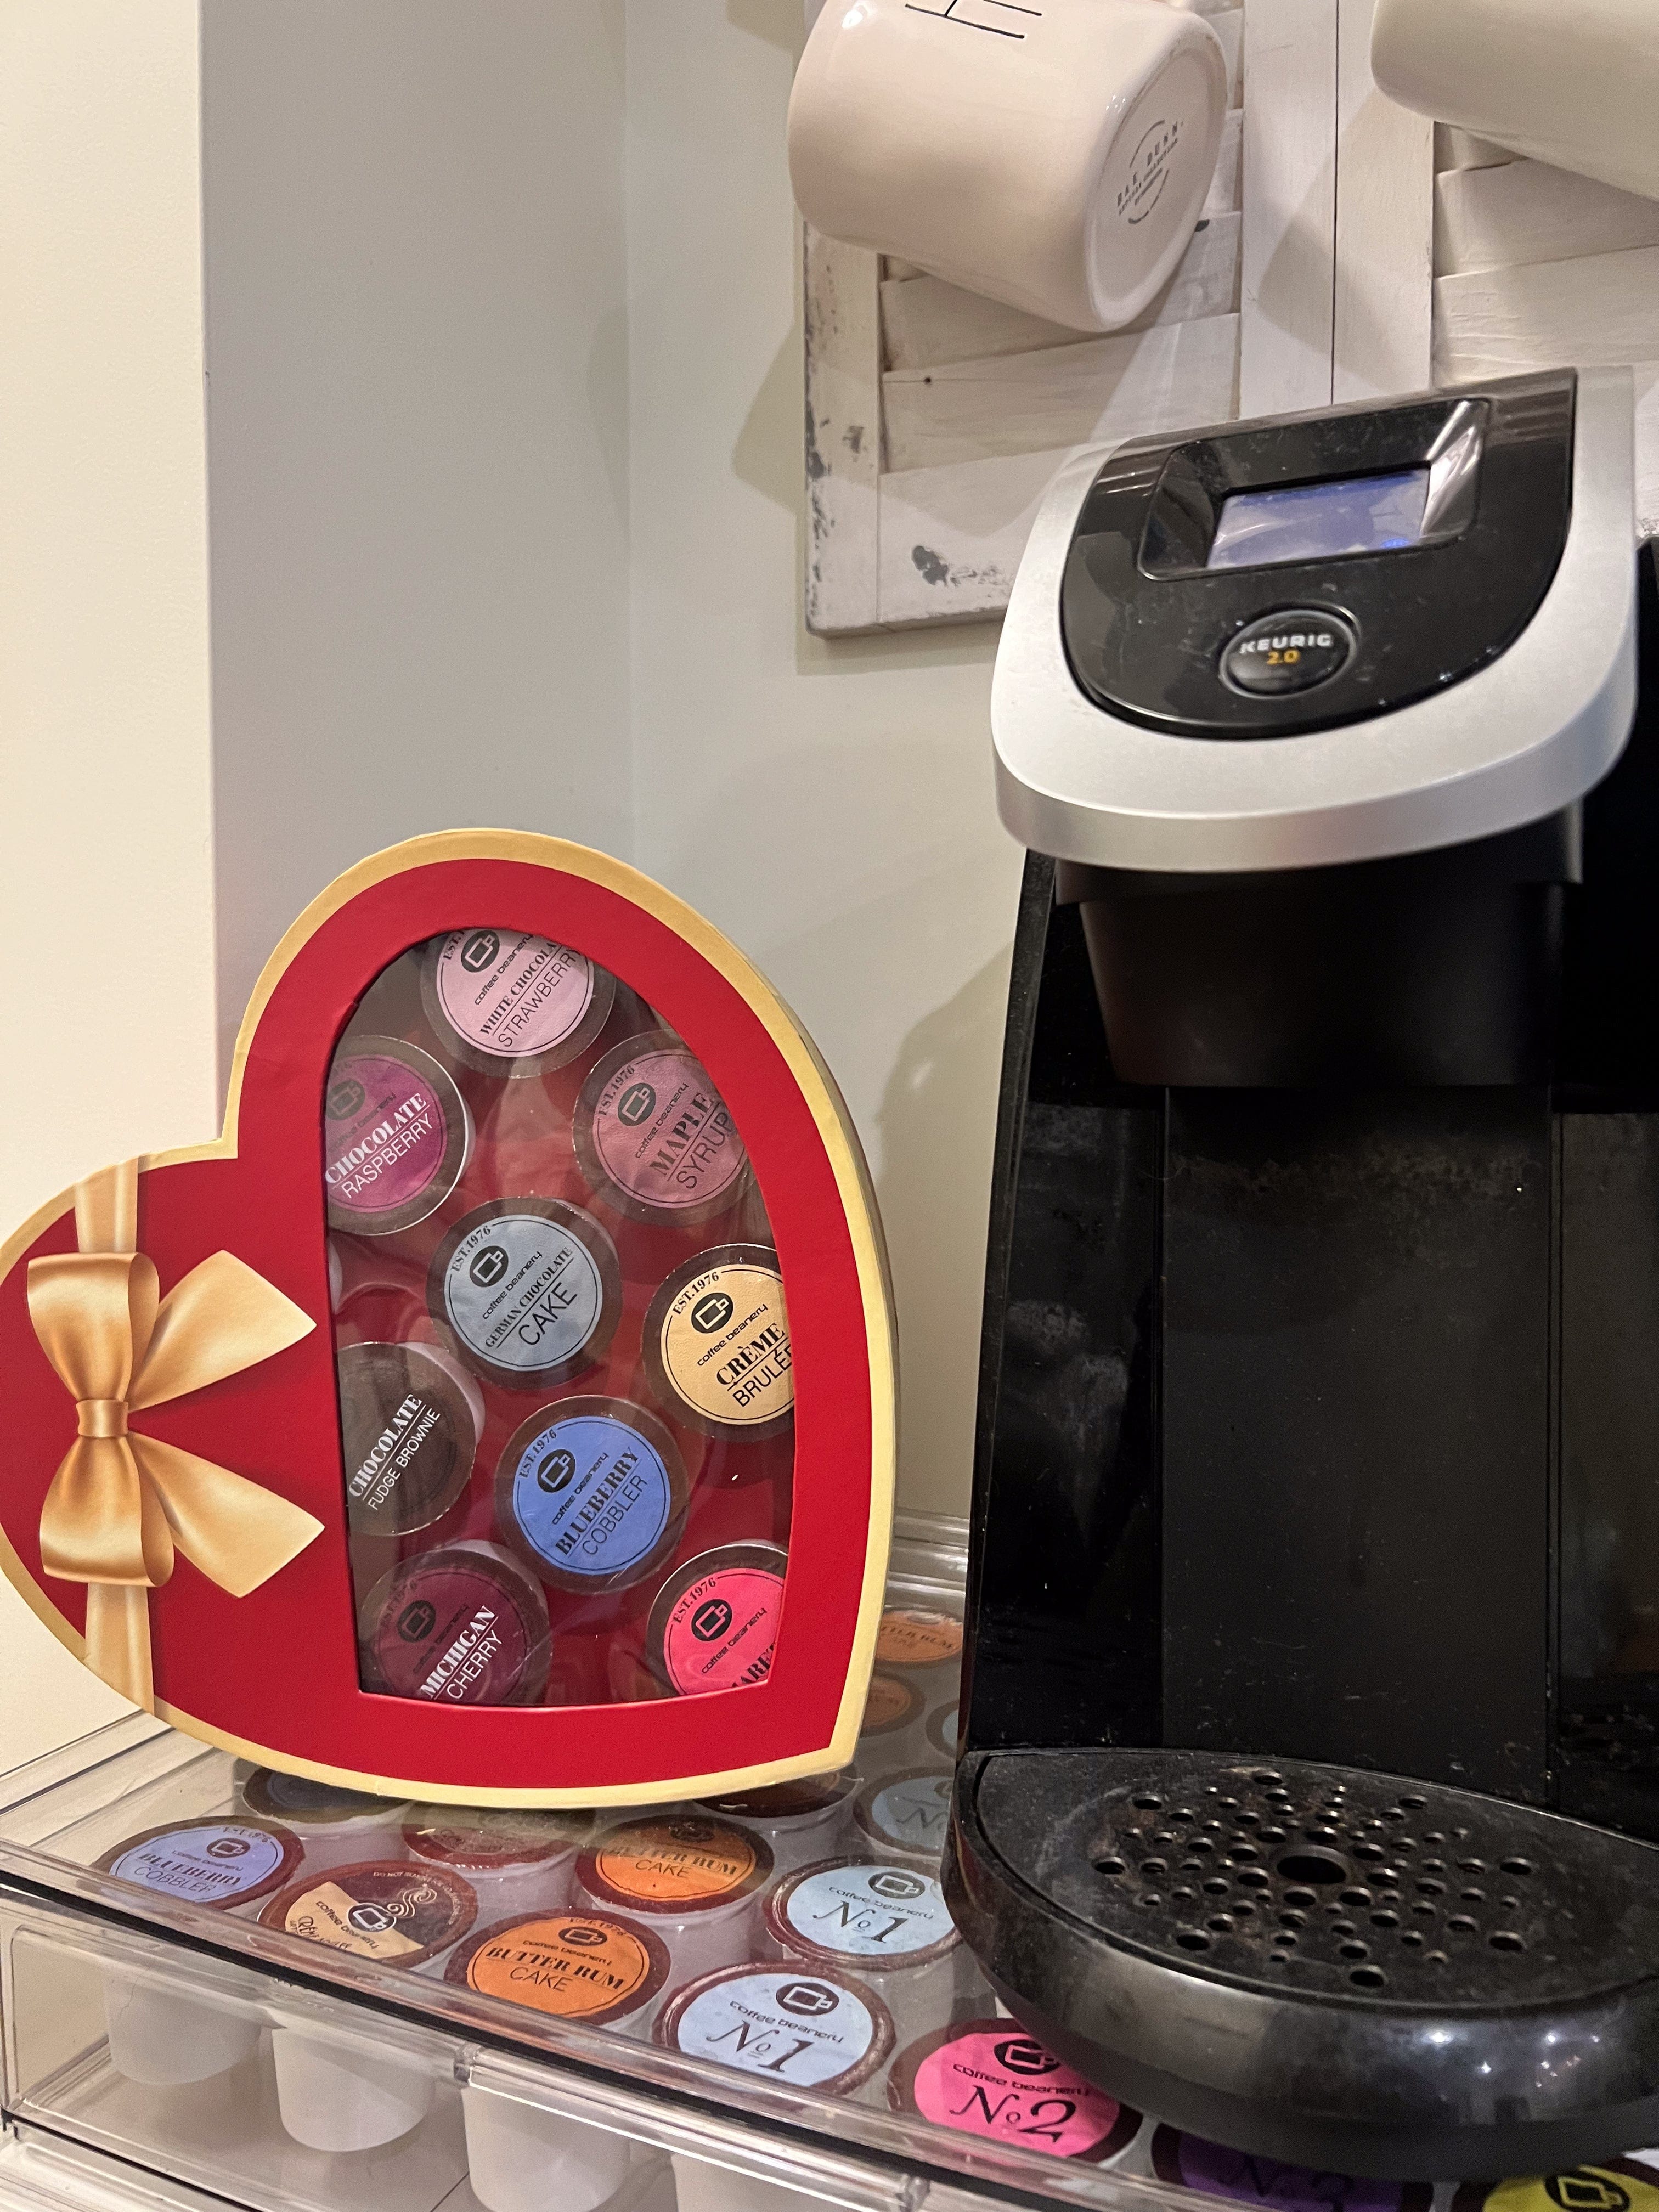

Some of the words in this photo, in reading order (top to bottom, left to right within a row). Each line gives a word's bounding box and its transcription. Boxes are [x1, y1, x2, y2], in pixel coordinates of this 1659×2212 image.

[1239, 633, 1333, 654] KEURIG
[1266, 648, 1302, 665] 2.0
[475, 974, 499, 1006] coffee
[496, 933, 534, 974] beanery
[479, 995, 514, 1035] WHITE
[510, 942, 557, 996] CHOCOLA
[599, 1065, 635, 1116] EST.1976
[635, 1127, 658, 1159] coffee
[656, 1082, 690, 1127] beanery
[325, 1093, 427, 1184] CHOCOLATE
[341, 1113, 433, 1199] RASPBERRY
[649, 1092, 713, 1177] MAPLE
[676, 1111, 734, 1189] SYRUP
[450, 1224, 492, 1272] EST.1976
[483, 1291, 508, 1320] coffee
[505, 1251, 543, 1291] beanery
[485, 1306, 522, 1348] GERMAN
[519, 1247, 573, 1308] CHOCOLATE
[518, 1282, 578, 1346] CAKE
[673, 1271, 720, 1316] EST.1976
[697, 1340, 727, 1367] coffee
[726, 1304, 769, 1340] beanery
[716, 1322, 786, 1386] CRÈME
[348, 1394, 423, 1497] CHOCOLATE
[368, 1468, 401, 1511] FUDGE
[395, 1407, 441, 1468] BROWNIE
[518, 1429, 558, 1479] EST.1976
[552, 1494, 576, 1525] coffee
[574, 1452, 610, 1495] beanery
[555, 1446, 640, 1556] BLUEBERRY
[583, 1474, 648, 1556] COBBLER
[673, 1577, 716, 1624] EST.1976
[419, 1605, 496, 1699] MICHIGAN
[447, 1629, 503, 1700] CHERRY
[701, 1646, 729, 1674] coffee
[727, 1607, 768, 1647] beanery
[134, 1866, 217, 1893] COBBLER
[138, 1853, 242, 1886] BLUEBERRY
[635, 1859, 692, 1878] CAKE
[315, 1901, 343, 1926] coffee
[828, 1886, 871, 1904] coffee
[873, 1900, 934, 1919] beanery
[486, 1948, 571, 1972] BUTTER
[574, 1965, 625, 1990] RUM
[510, 1967, 573, 1993] CAKE
[730, 2000, 775, 2024] coffee
[778, 2018, 844, 2044] beanery
[953, 2063, 1008, 2085] coffee
